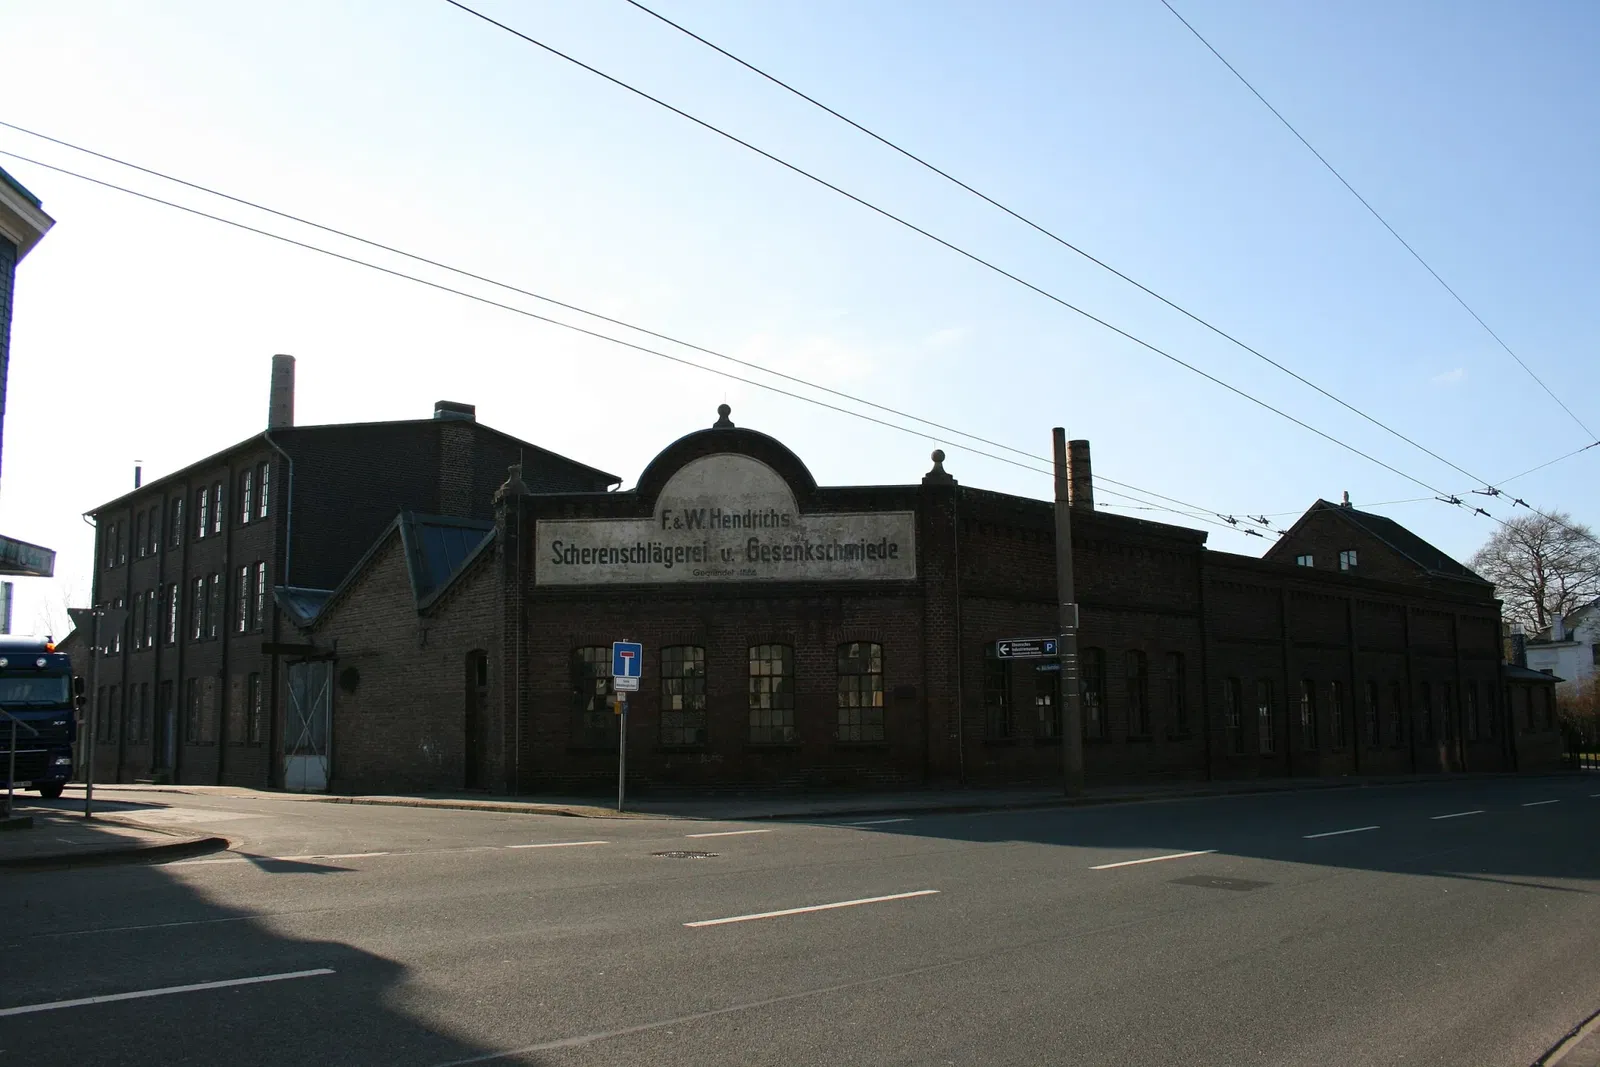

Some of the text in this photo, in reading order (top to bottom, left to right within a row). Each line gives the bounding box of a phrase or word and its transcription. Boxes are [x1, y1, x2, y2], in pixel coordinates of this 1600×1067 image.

[709, 508, 791, 530] Hendrichs
[551, 539, 708, 569] Scherenschlägerei
[746, 536, 899, 563] Gesenkschmiede
[1046, 643, 1053, 652] P
